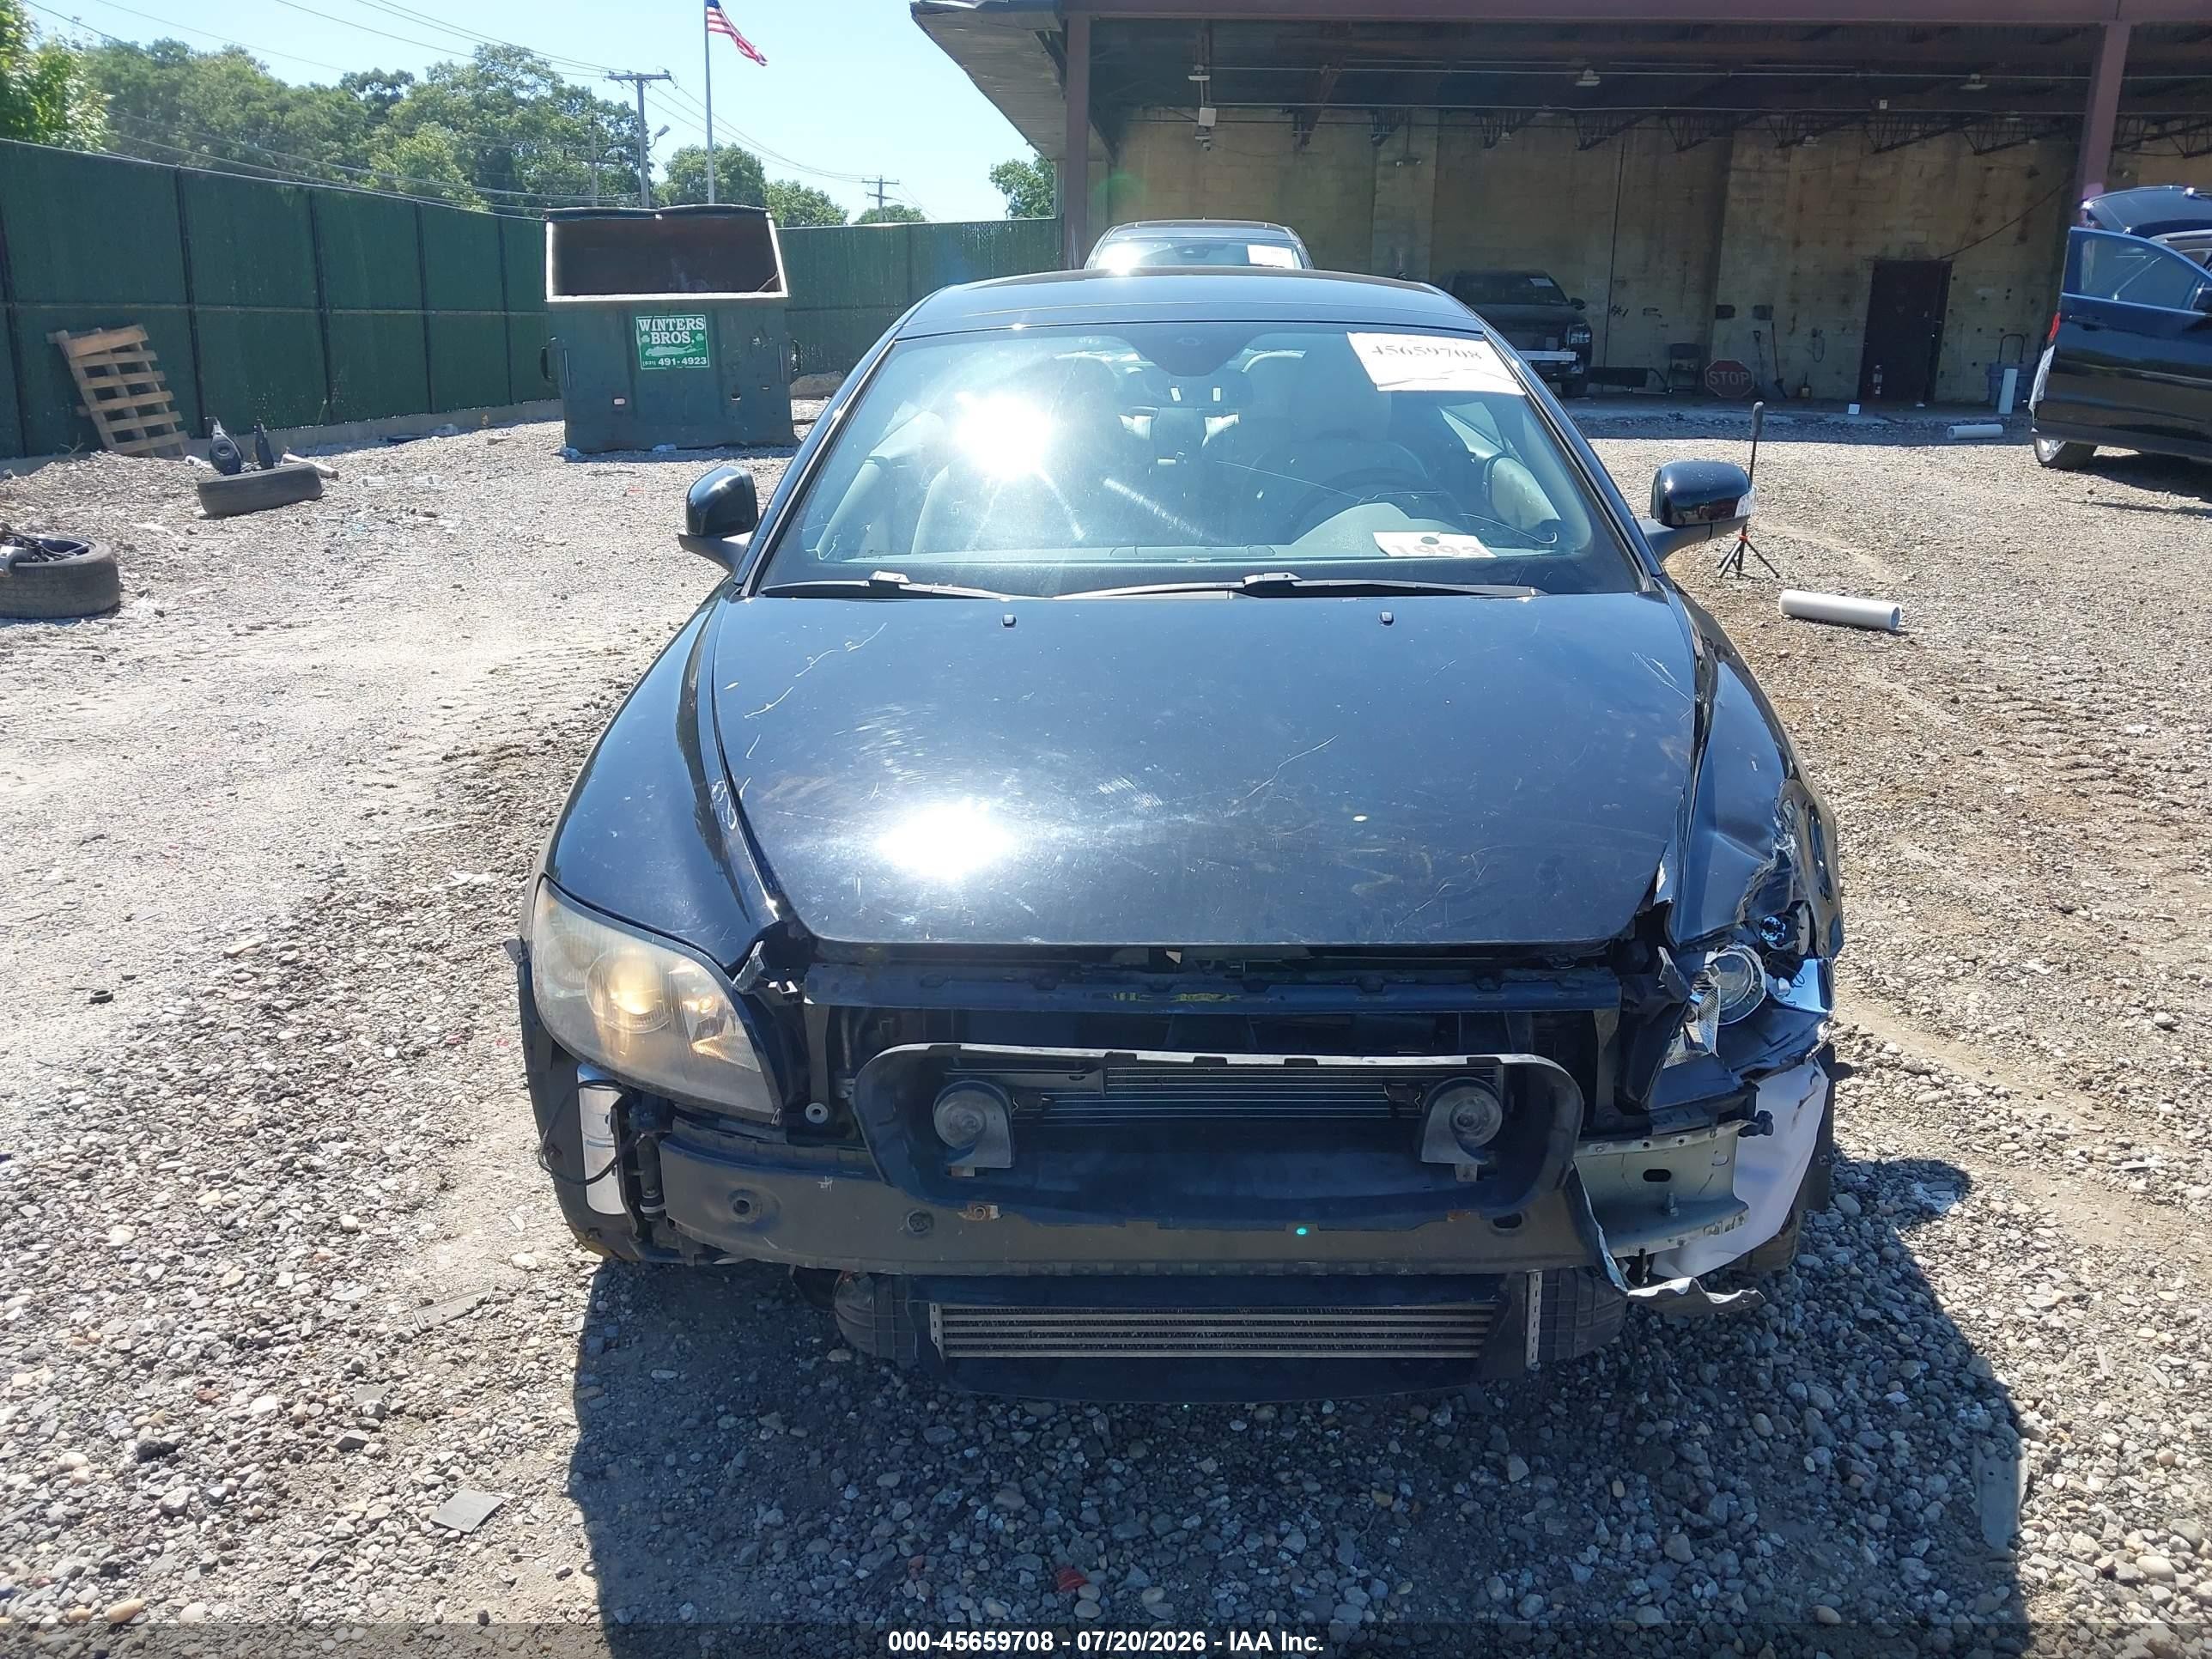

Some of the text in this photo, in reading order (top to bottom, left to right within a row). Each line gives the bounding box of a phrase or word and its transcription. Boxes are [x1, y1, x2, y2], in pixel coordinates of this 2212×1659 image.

[638, 318, 705, 331] WINTERS
[650, 331, 695, 344] BROS.
[658, 356, 707, 366] 491-4923
[1709, 370, 1749, 386] STOP
